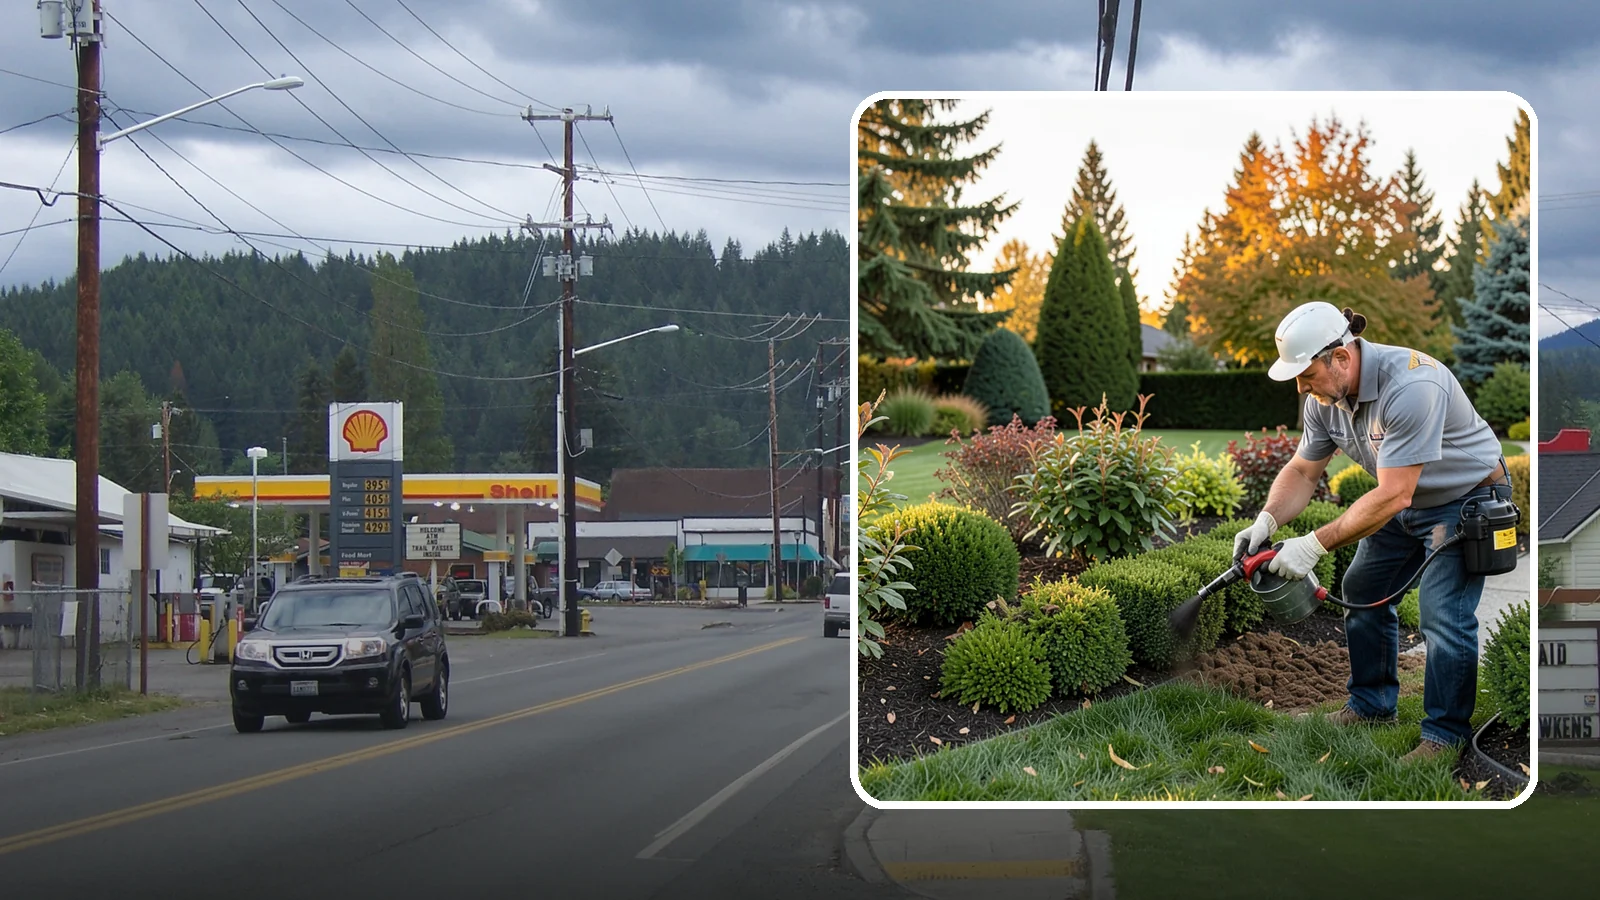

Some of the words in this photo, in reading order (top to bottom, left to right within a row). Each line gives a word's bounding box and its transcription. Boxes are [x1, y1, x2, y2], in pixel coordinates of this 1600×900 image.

[366, 480, 383, 490] 395
[490, 484, 547, 499] Shell
[366, 494, 383, 504] 405
[366, 508, 383, 518] 415
[366, 522, 383, 532] 429
